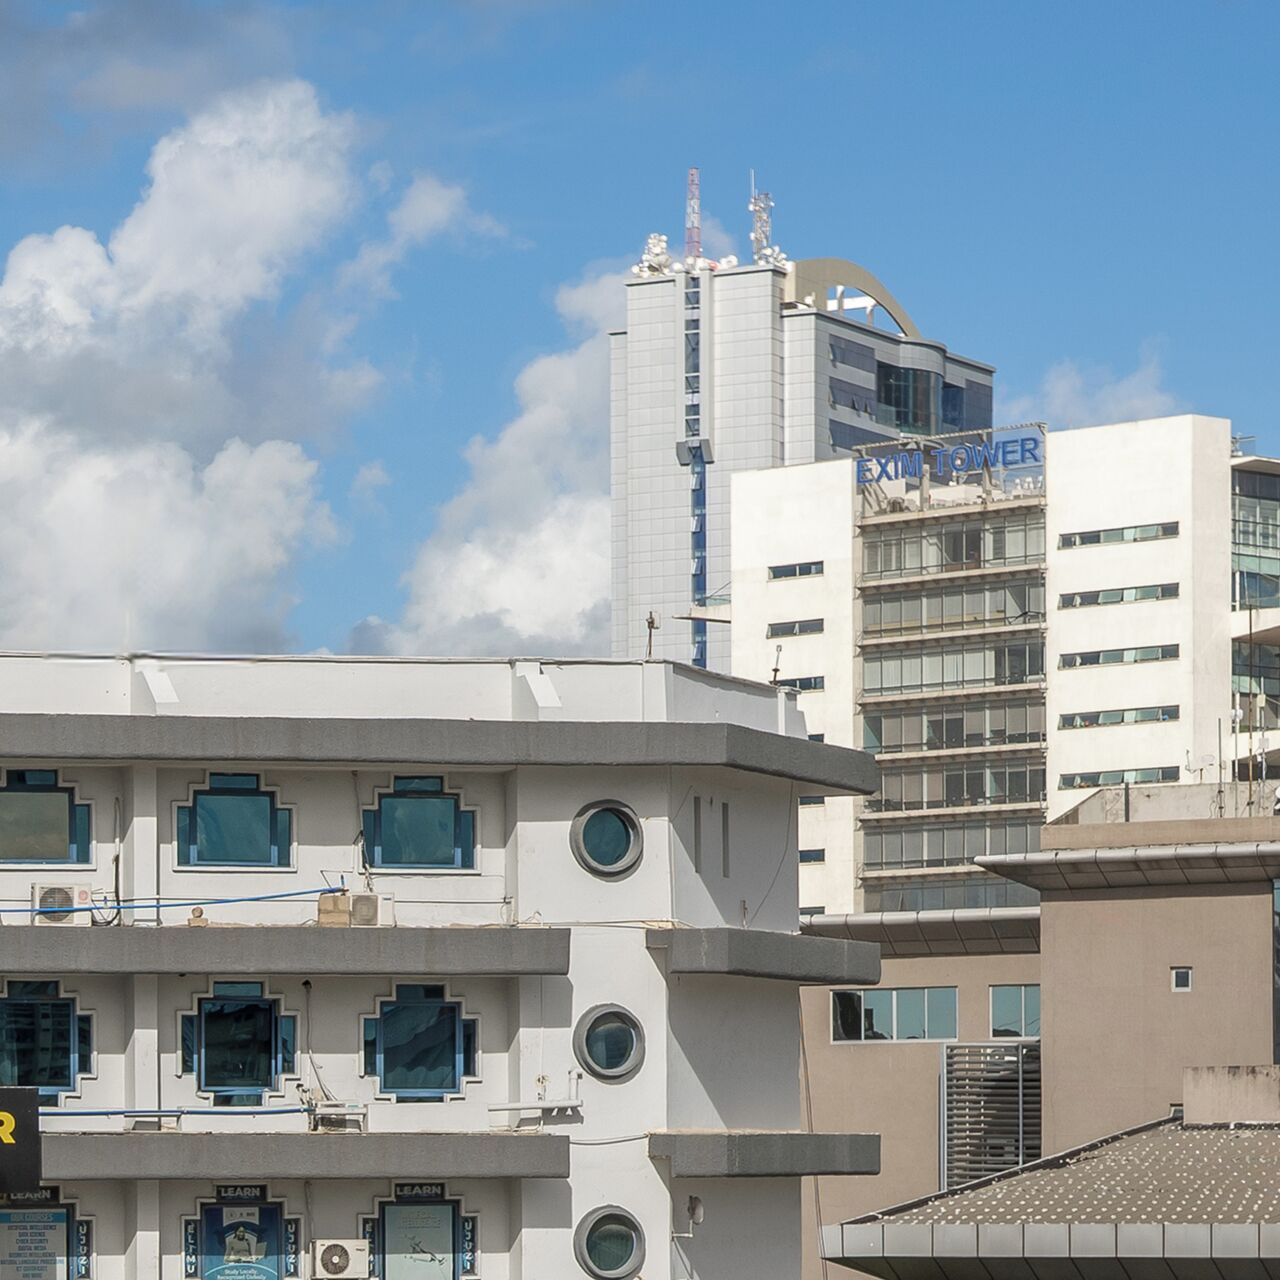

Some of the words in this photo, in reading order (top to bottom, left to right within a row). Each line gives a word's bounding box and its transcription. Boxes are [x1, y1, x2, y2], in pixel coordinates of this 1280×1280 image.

[856, 451, 924, 484] EXIM
[931, 437, 1040, 475] TOWER
[10, 1189, 51, 1199] LEARN
[221, 1186, 261, 1197] LEARN
[396, 1185, 441, 1196] LEARN
